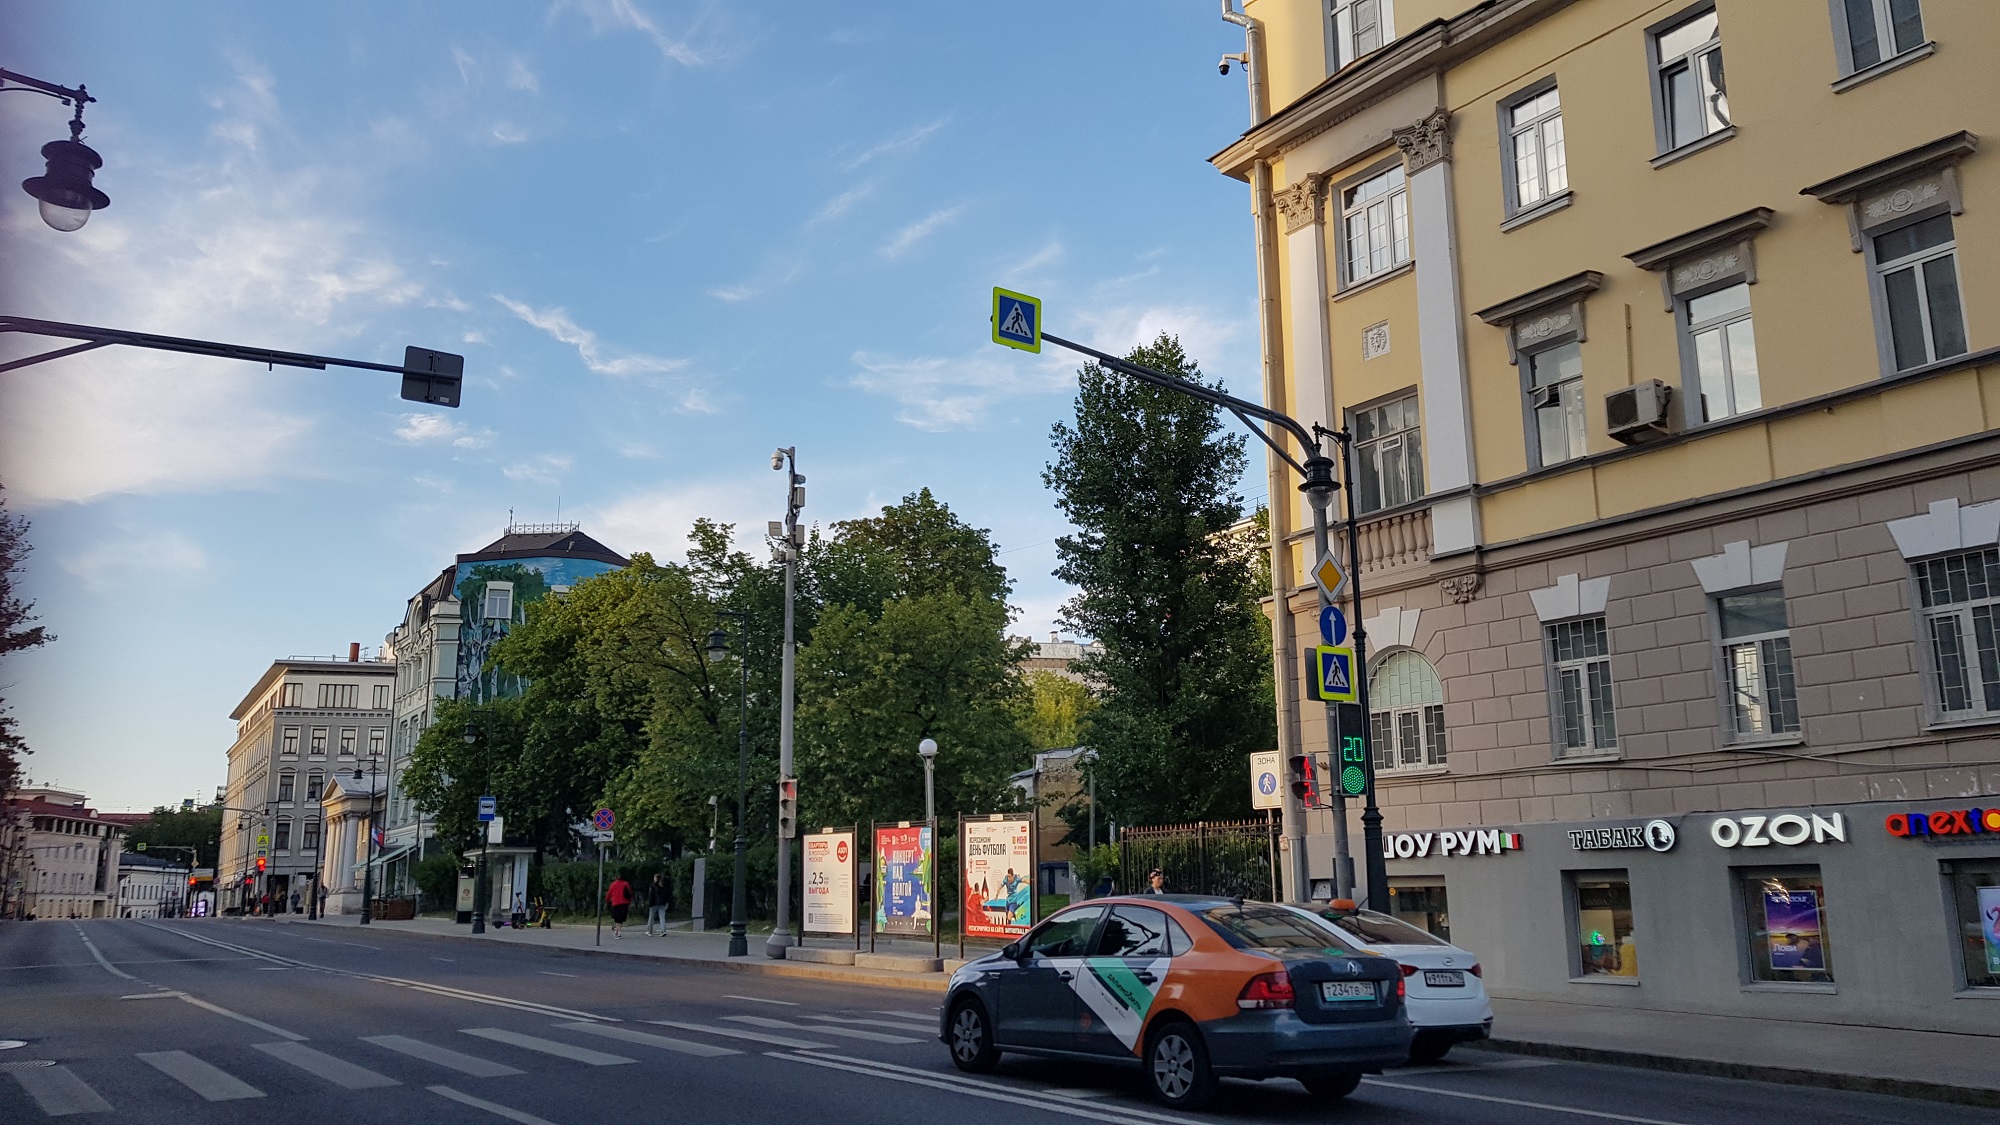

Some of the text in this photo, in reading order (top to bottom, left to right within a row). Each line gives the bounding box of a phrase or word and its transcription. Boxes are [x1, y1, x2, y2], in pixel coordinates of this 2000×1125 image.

[1343, 737, 1364, 762] 20
[1257, 756, 1276, 765] ЗОНА
[1711, 812, 1846, 848] OZON
[1440, 829, 1503, 857] РУМ
[1568, 827, 1645, 850] ТАБАК
[893, 850, 914, 866] КОНЦЕРТ
[969, 844, 982, 857] ДЕНЬ
[983, 844, 1006, 855] ФУТБОЛА
[812, 872, 824, 886] 2,5
[893, 866, 903, 881] НАД
[808, 887, 829, 895] ВЫГОДА
[893, 881, 912, 896] ВОЛГОЙ
[1325, 983, 1360, 997] Т234ТВ
